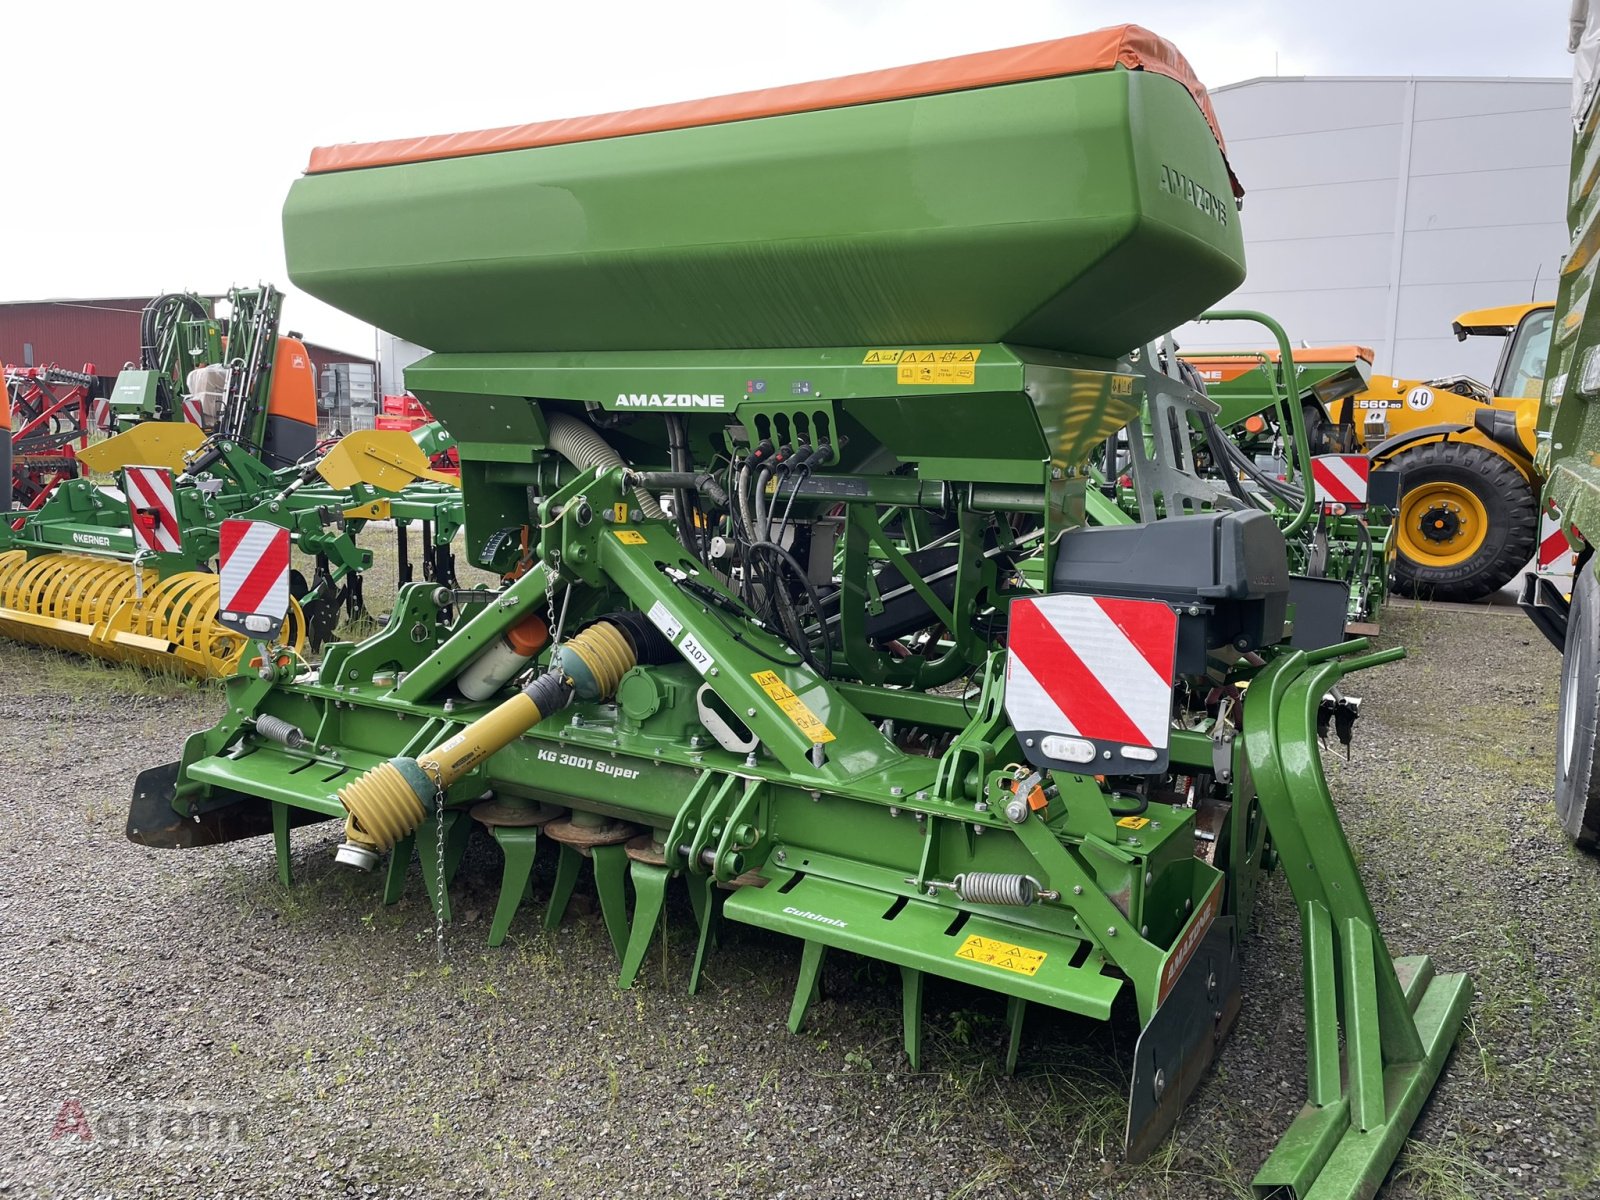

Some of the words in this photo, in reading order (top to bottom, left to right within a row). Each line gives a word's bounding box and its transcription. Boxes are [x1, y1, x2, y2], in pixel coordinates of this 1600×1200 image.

[1159, 164, 1227, 226] AMAZONE
[615, 393, 724, 408] AMAZONE
[1412, 391, 1428, 406] 40
[78, 533, 110, 547] KERNER
[685, 640, 707, 664] 2107
[537, 749, 557, 763] KG
[559, 754, 594, 770] 3001
[595, 761, 639, 779] Super
[782, 906, 849, 929] Cultimix
[1166, 902, 1212, 984] AMAZONE
